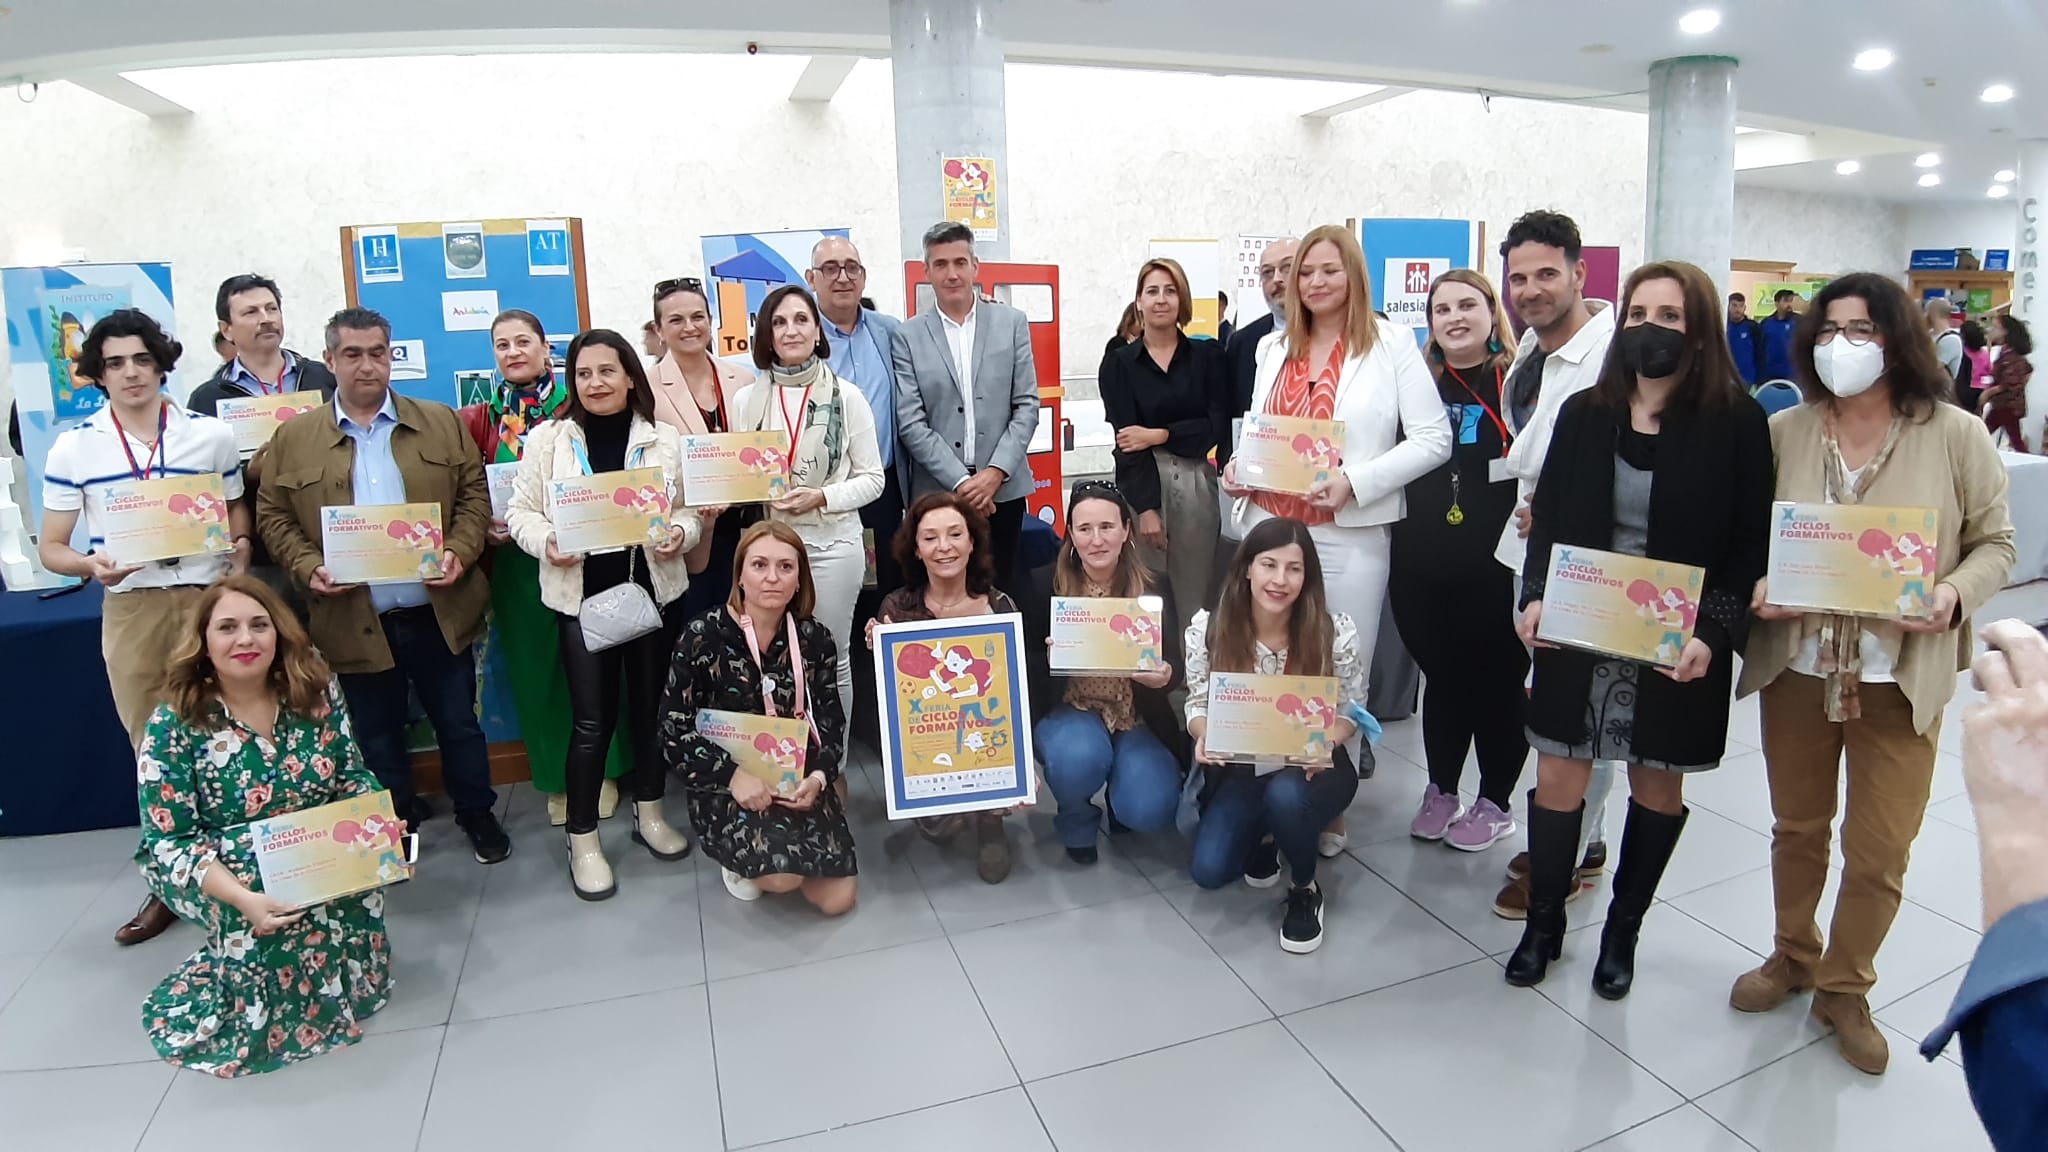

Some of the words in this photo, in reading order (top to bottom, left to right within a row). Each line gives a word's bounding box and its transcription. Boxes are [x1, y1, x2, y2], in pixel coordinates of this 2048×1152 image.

[536, 232, 561, 250] AT
[1386, 298, 1426, 313] salesia
[687, 438, 696, 447] X
[687, 451, 736, 460] FORMATIVOS
[554, 483, 565, 492] X
[563, 488, 593, 498] CICLOS
[556, 493, 610, 506] FORMATIVOS
[329, 509, 338, 519] X
[1782, 507, 1794, 521] X
[336, 518, 366, 526] CICLOS
[1792, 522, 1831, 530] CICLOS
[328, 524, 384, 533] FORMATIVOS
[1780, 530, 1854, 541] FORMATIVOS
[1561, 550, 1572, 563] X
[1567, 563, 1604, 577] CICLOS
[1556, 570, 1624, 588] FORMATIVOS
[1057, 601, 1066, 610] X
[1216, 677, 1227, 688] X
[1224, 687, 1255, 695] CICLOS
[1215, 694, 1273, 703] FORMATIVOS
[909, 699, 923, 714] X
[925, 704, 952, 713] FERIA
[703, 712, 712, 723] X
[709, 723, 736, 732] CICLOS
[700, 730, 752, 741] FORMATIVOS
[259, 823, 272, 837] X
[271, 827, 307, 842] CICLOS
[263, 829, 329, 852] FORMATIVOS
